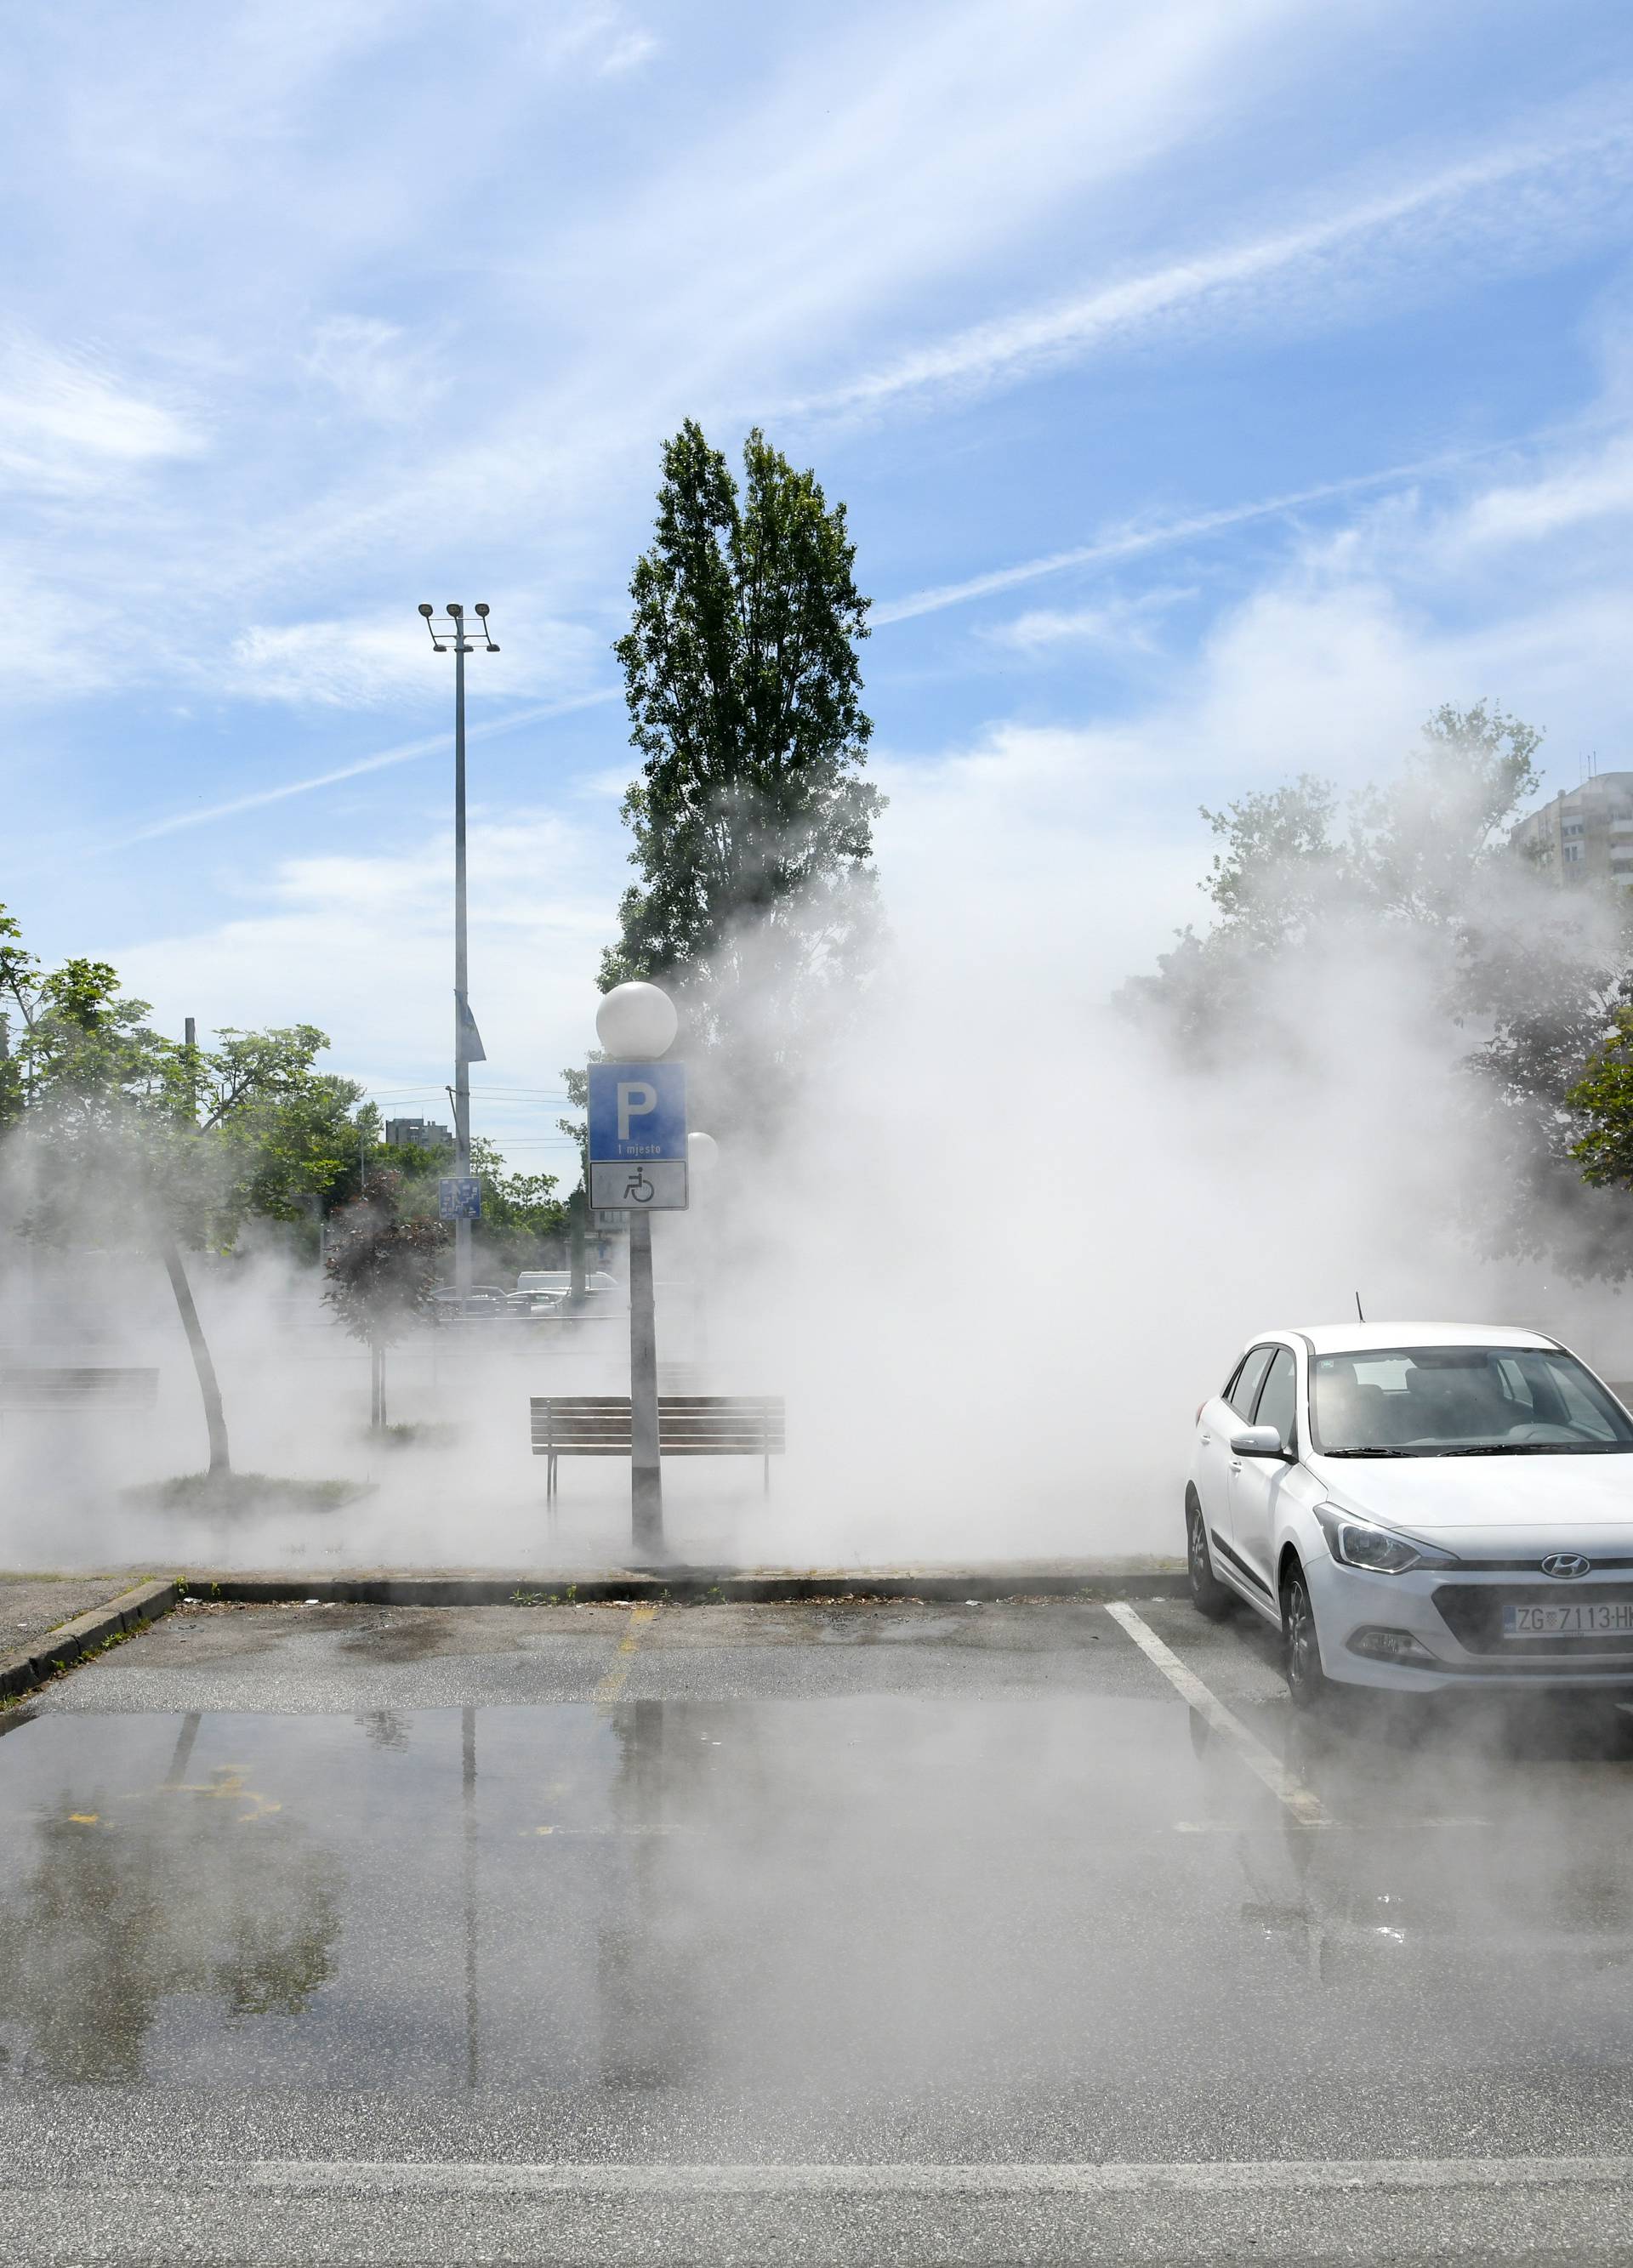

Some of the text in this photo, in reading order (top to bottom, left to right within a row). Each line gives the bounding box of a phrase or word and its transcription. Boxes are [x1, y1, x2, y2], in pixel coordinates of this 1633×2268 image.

[617, 1082, 657, 1140] P
[627, 1144, 661, 1157] mjesto
[1518, 1608, 1545, 1630] ZG
